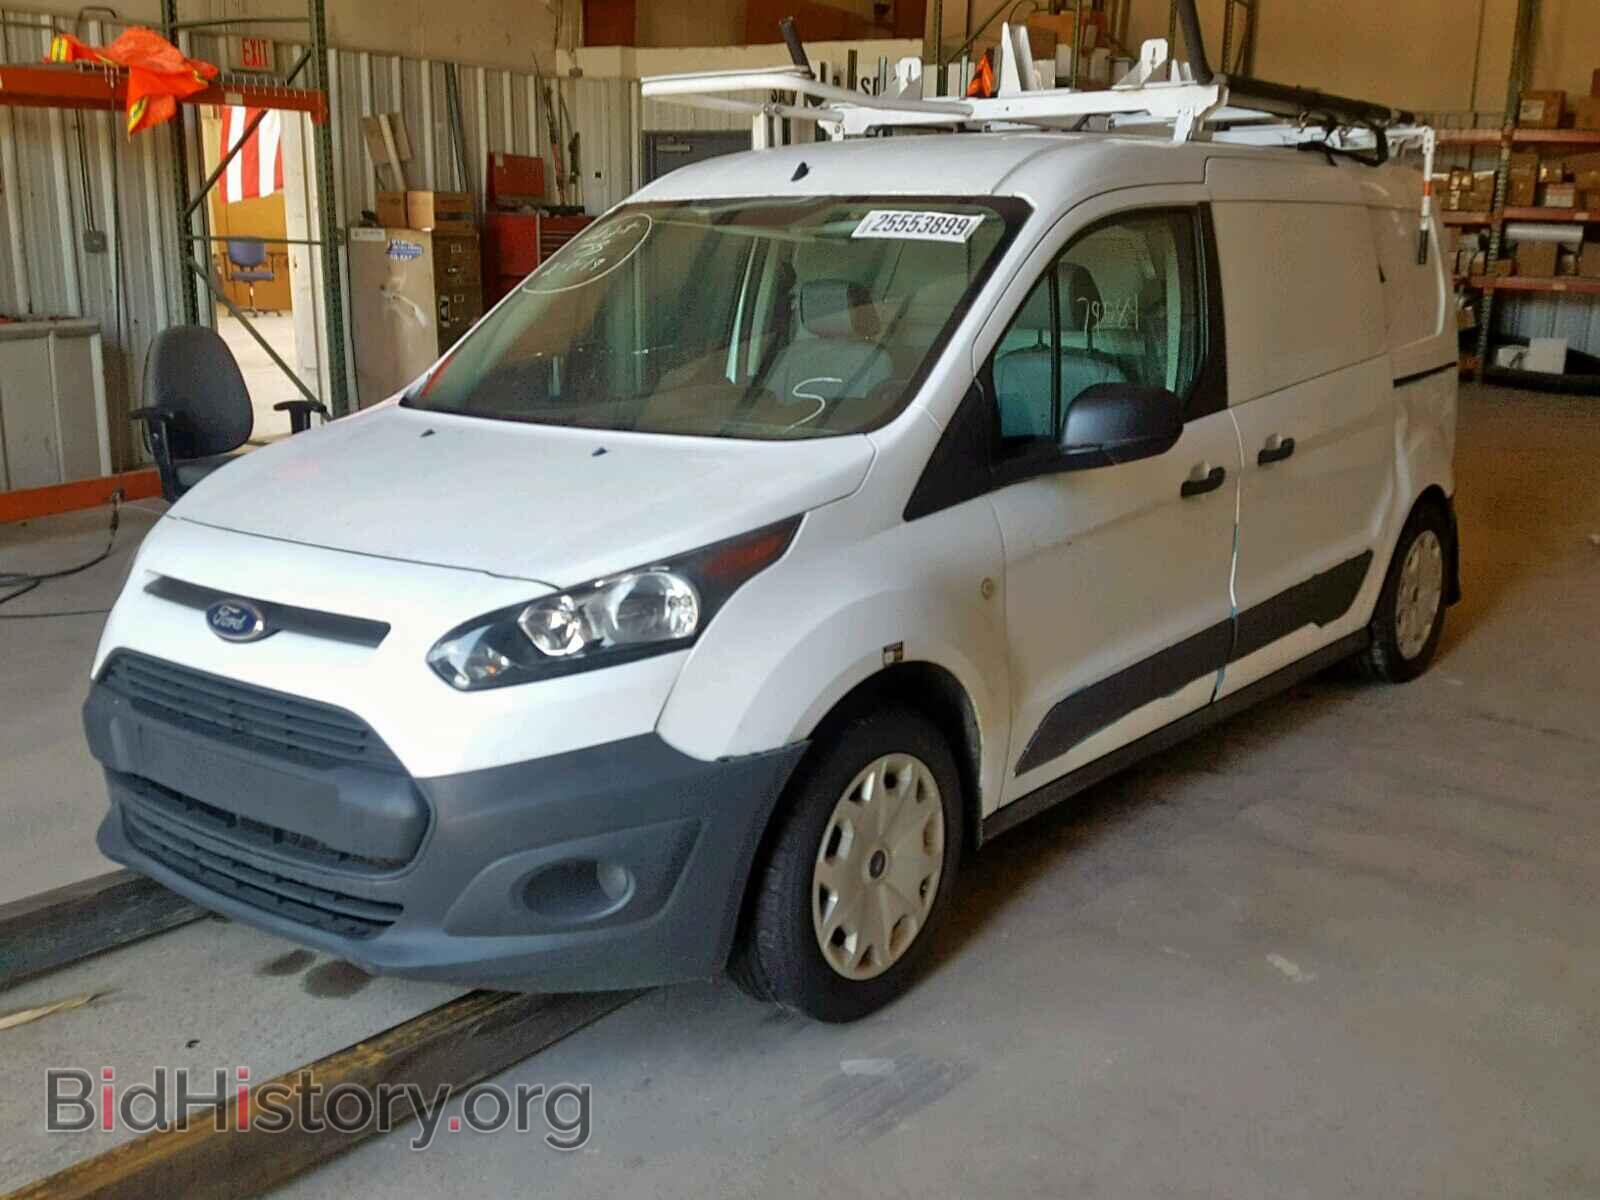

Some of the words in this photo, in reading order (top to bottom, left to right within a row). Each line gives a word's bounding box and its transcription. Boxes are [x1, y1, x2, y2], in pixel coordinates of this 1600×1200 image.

[242, 38, 272, 68] EXIT
[870, 213, 970, 236] 25553899
[211, 605, 248, 631] Ford
